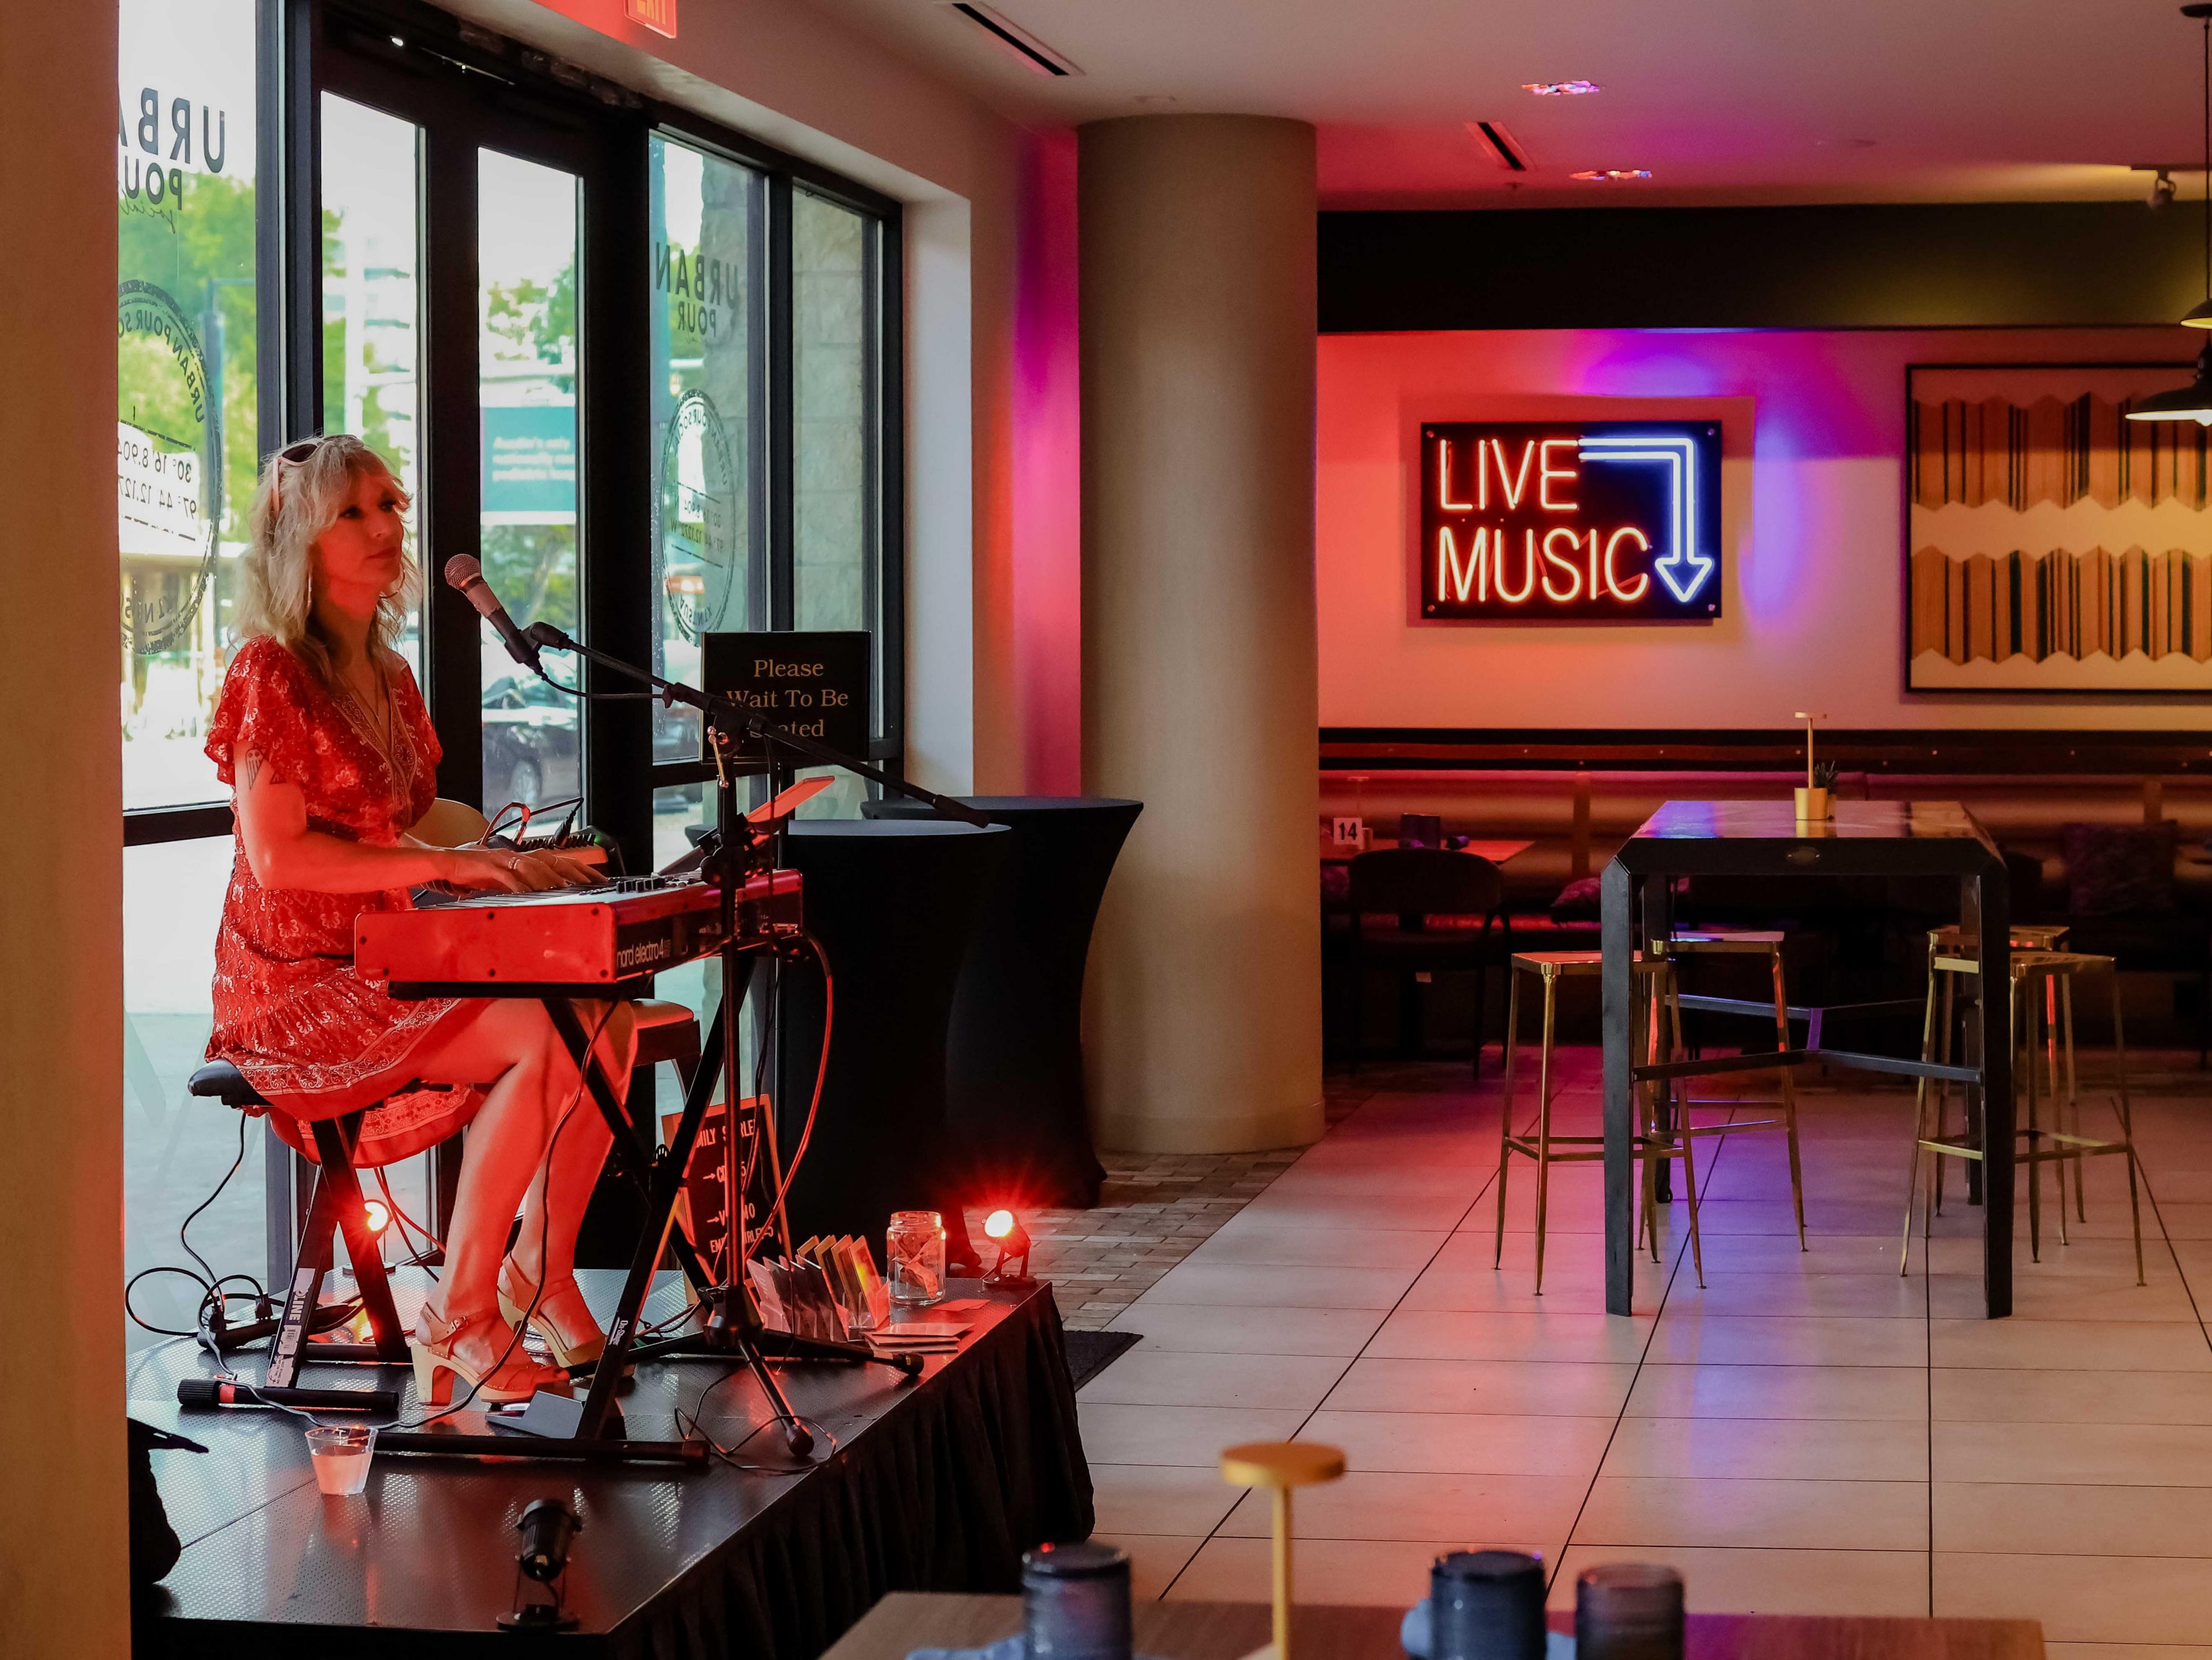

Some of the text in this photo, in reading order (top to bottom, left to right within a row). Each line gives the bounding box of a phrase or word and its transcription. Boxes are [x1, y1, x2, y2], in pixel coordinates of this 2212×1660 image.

[1439, 438, 1578, 511] LIVE
[1438, 525, 1649, 603] MUSIC
[754, 659, 824, 677] Please
[726, 689, 849, 708] Wait To Be
[1339, 823, 1358, 841] 14
[617, 944, 634, 969] nord
